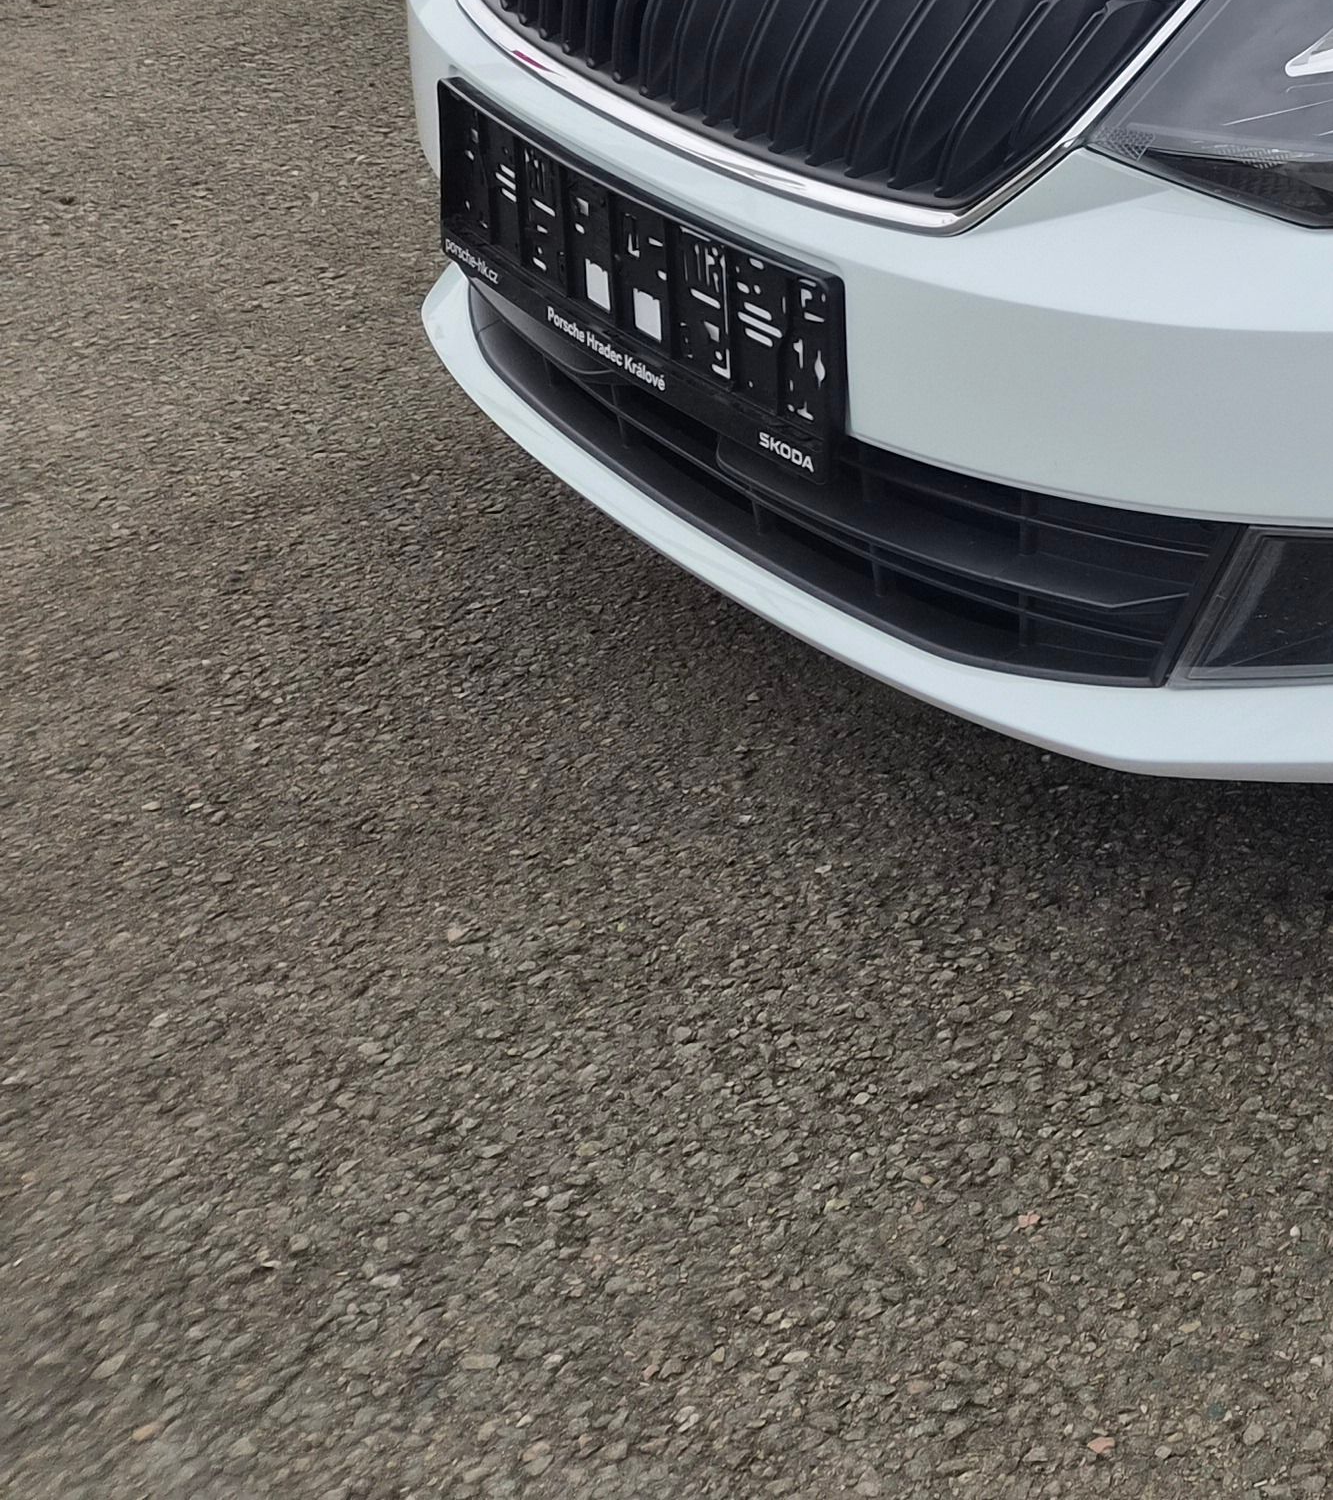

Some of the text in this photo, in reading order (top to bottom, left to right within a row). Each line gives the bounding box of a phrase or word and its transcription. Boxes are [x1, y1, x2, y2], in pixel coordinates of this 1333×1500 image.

[445, 238, 499, 285] porsche-hk.cz
[547, 306, 666, 392] Porsche Hradec Králové
